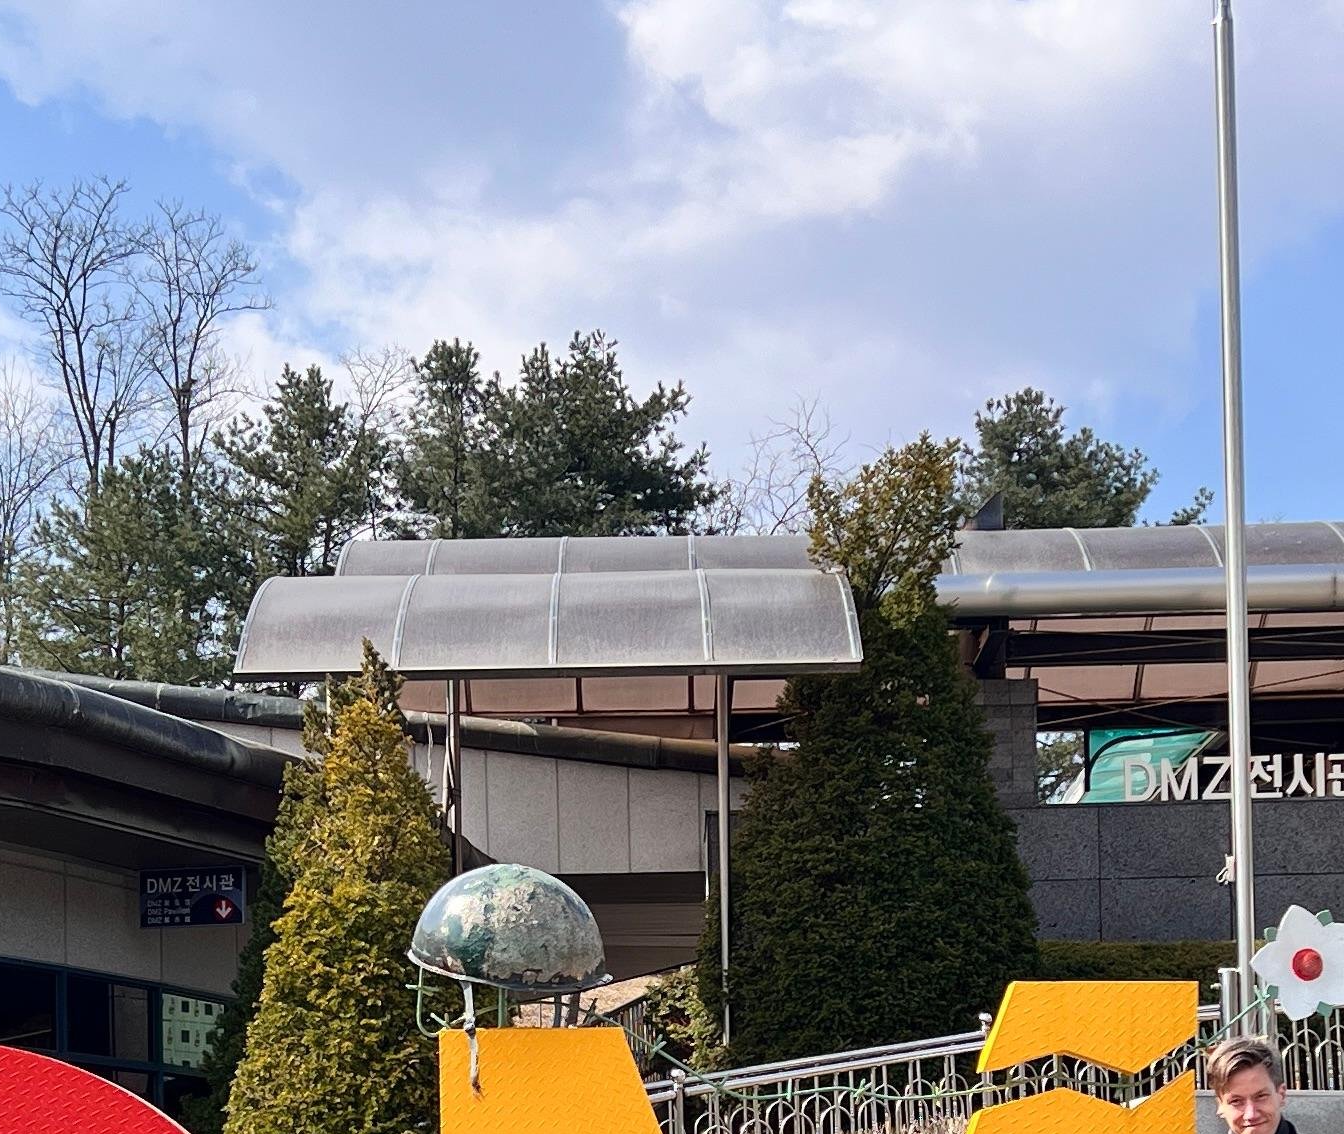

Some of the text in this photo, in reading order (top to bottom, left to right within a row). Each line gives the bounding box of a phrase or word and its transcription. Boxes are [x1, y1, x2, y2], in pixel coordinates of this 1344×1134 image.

[1122, 753, 1233, 802] DMZ
[146, 873, 235, 894] DMZ 전시관
